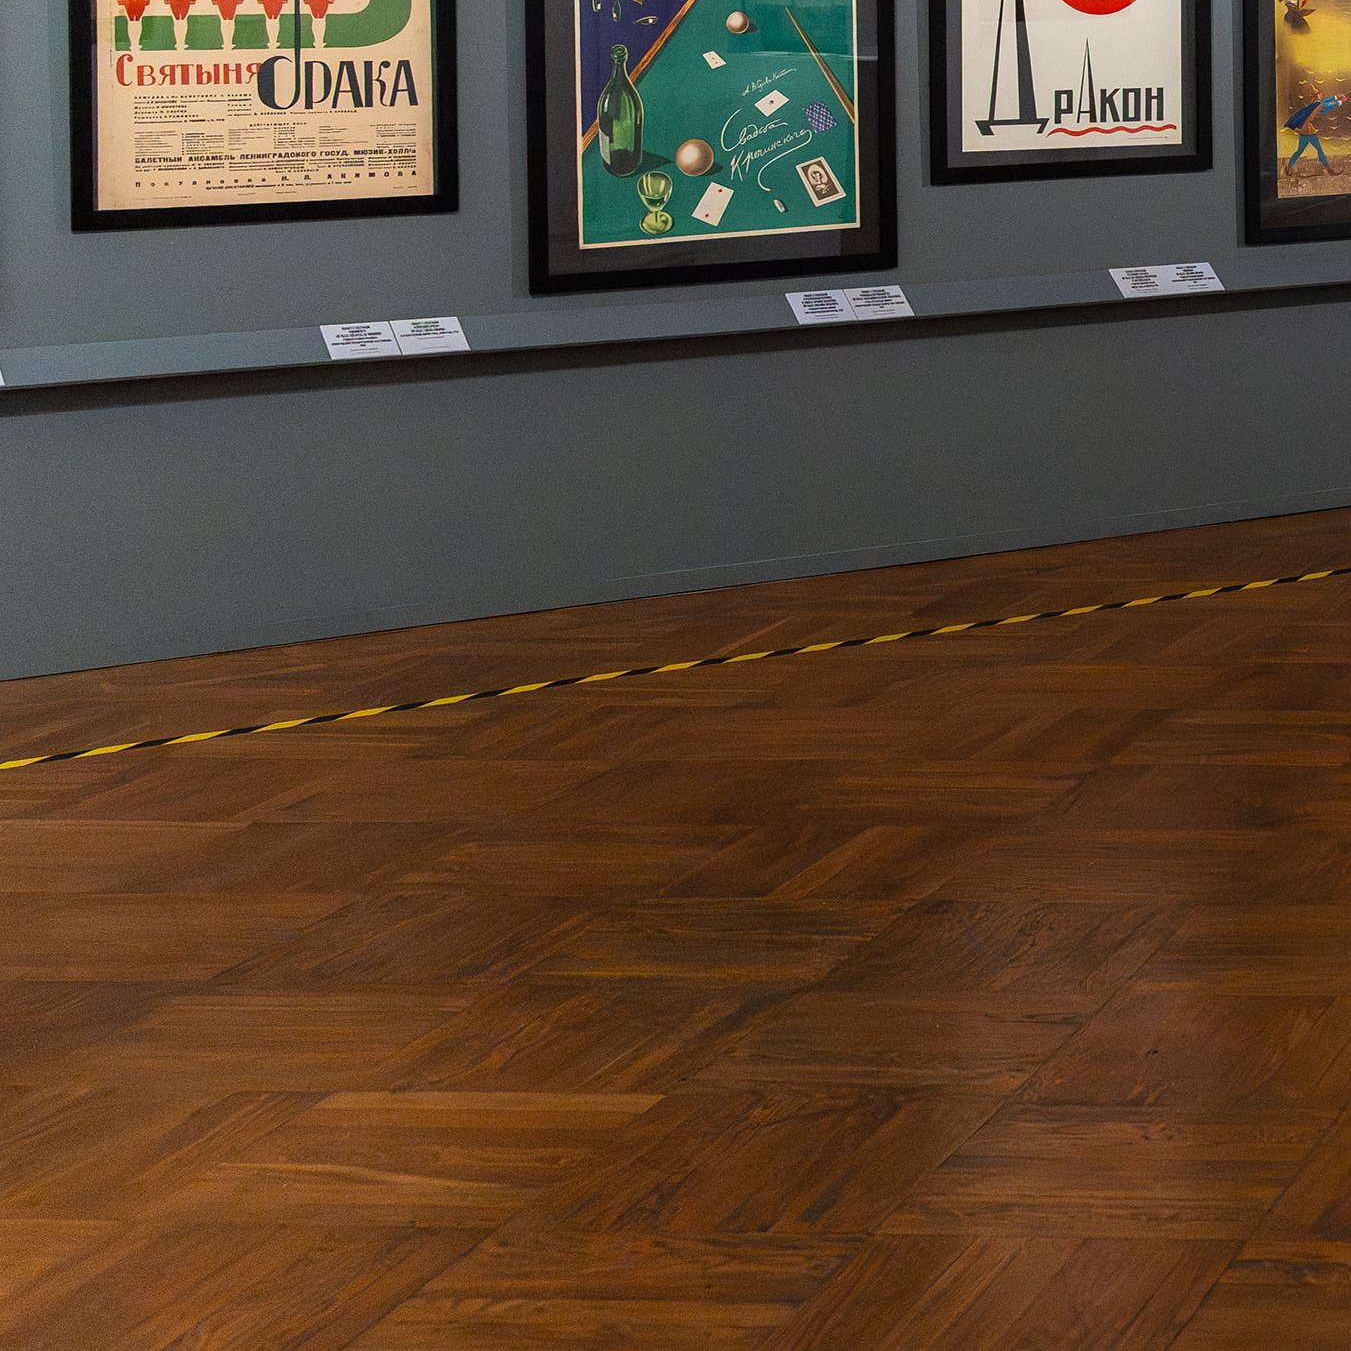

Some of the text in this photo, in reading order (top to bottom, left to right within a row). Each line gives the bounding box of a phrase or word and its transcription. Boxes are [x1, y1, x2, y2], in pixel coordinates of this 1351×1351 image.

[134, 156, 182, 164] БАЛЕТНЫЙ
[188, 154, 236, 162] АНСАМБЛЬ
[239, 151, 317, 160] ЛЕНИНГРАДСКОГО
[326, 169, 417, 180] АКИМОВА
